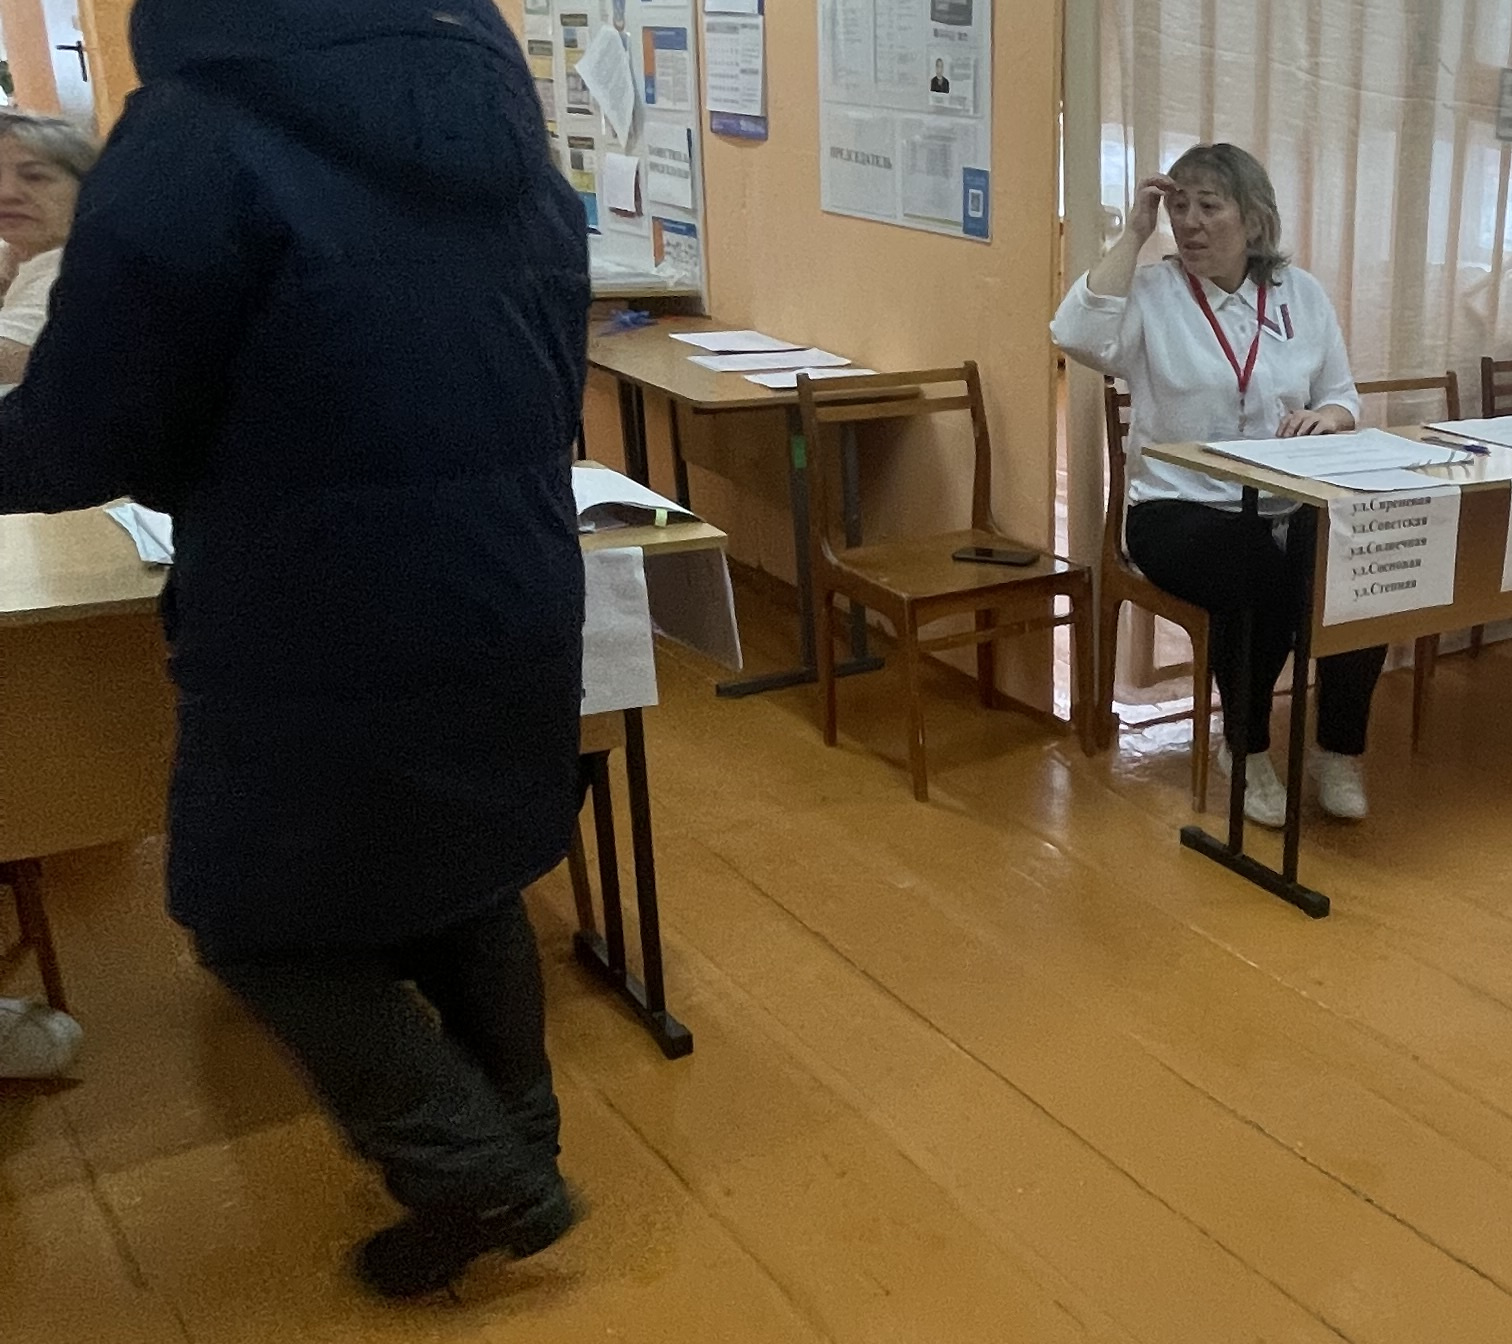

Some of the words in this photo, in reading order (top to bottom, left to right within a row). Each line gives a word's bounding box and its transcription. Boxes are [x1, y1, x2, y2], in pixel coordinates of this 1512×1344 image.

[1351, 516, 1428, 537] ул.Советская
[1350, 558, 1422, 580] ул.Сосновая
[1353, 579, 1417, 602] ул.Степная
